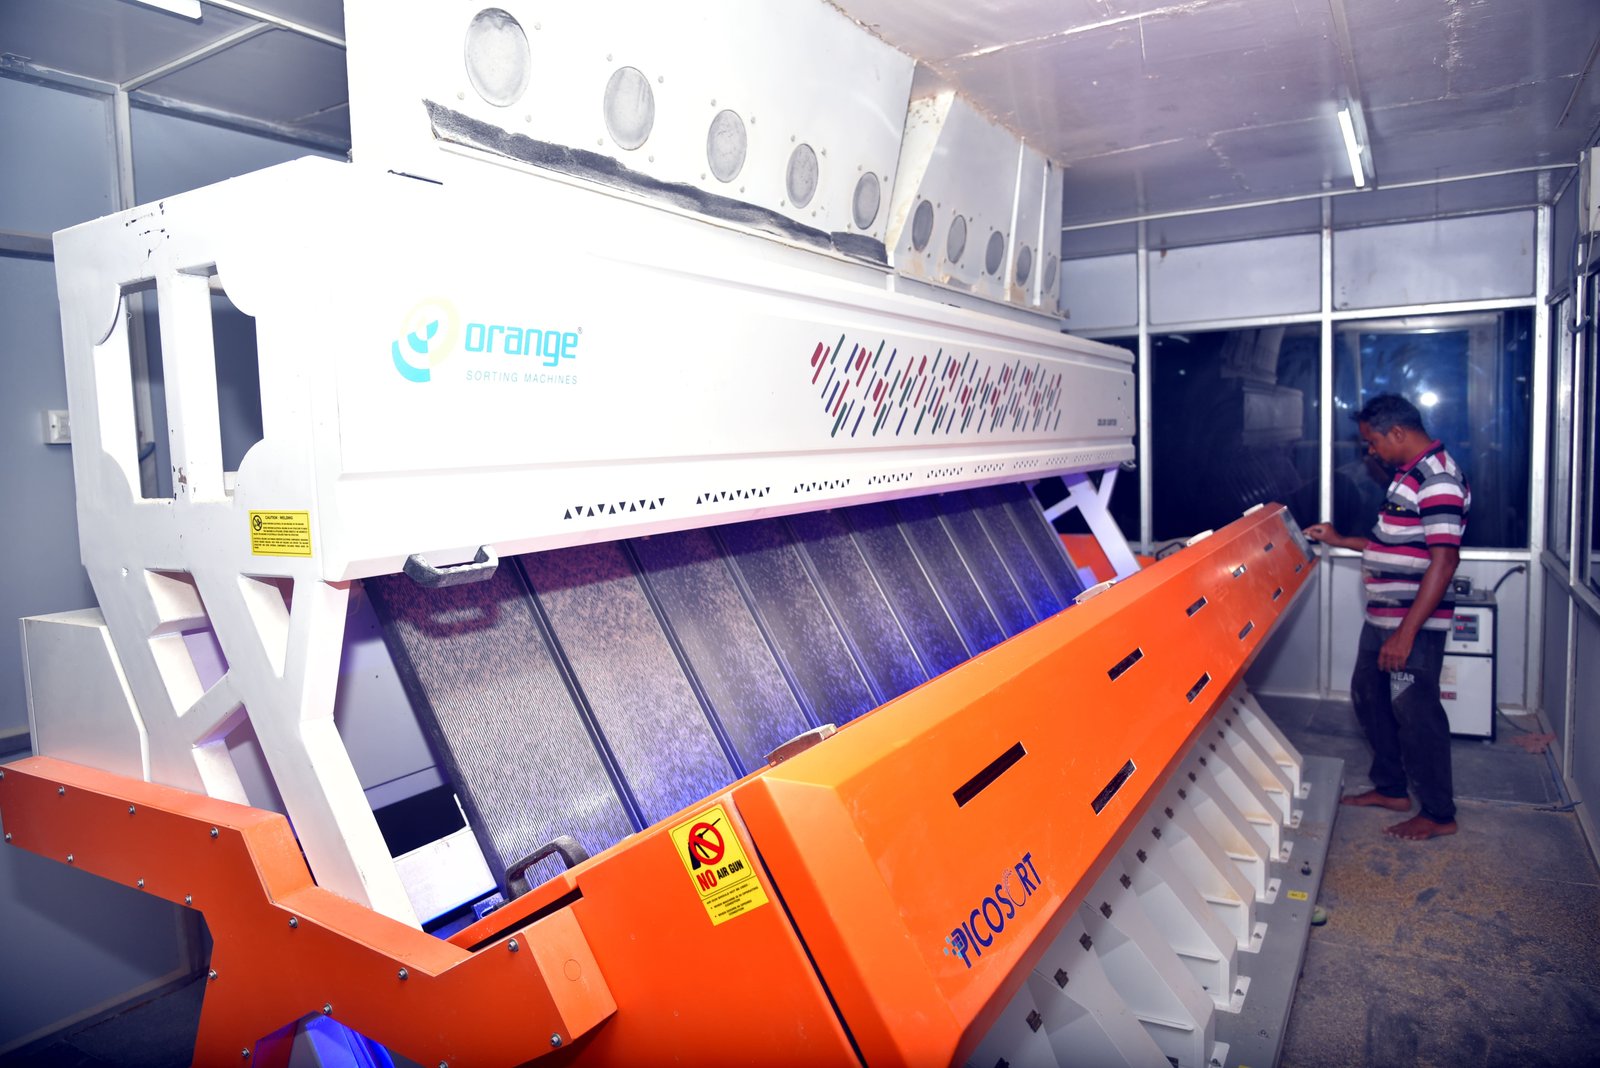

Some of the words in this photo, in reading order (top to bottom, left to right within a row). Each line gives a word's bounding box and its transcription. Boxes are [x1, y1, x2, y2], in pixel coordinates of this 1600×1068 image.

[465, 322, 579, 367] orange
[466, 370, 518, 383] SORTING
[523, 373, 578, 385] MACHINES
[696, 869, 717, 891] NO
[716, 866, 729, 880] AIR
[728, 859, 744, 874] GUN
